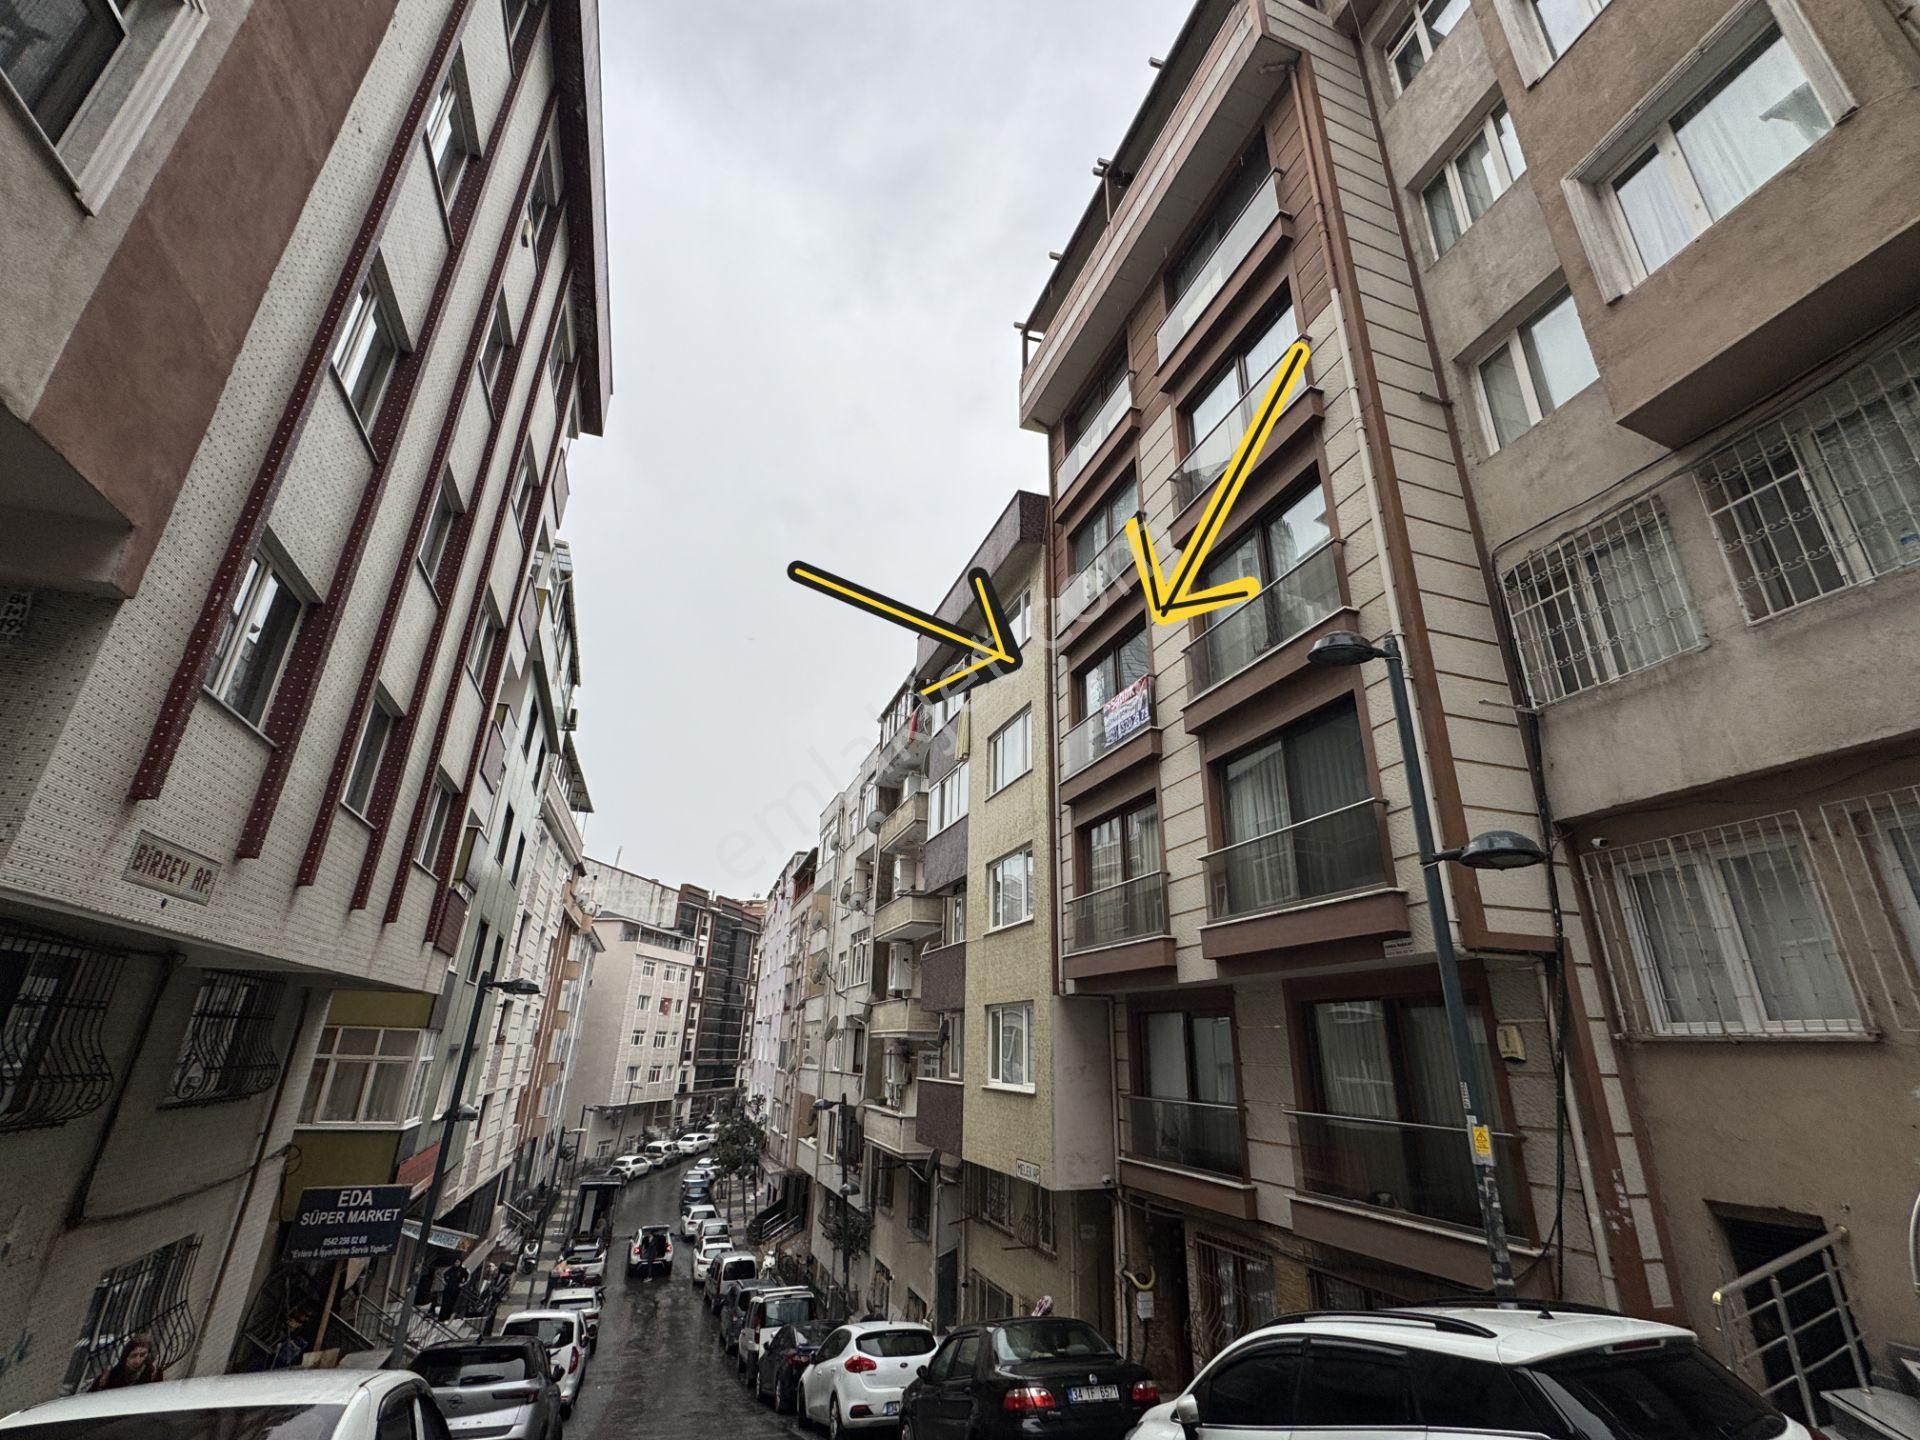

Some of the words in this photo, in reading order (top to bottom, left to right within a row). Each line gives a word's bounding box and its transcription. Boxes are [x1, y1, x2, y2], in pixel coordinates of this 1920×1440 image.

[131, 844, 191, 885] BİRBEY
[337, 1189, 374, 1208] EDA
[300, 1209, 346, 1227] SÜPER
[346, 1208, 401, 1224] MARKET
[1072, 1388, 1083, 1400] 34
